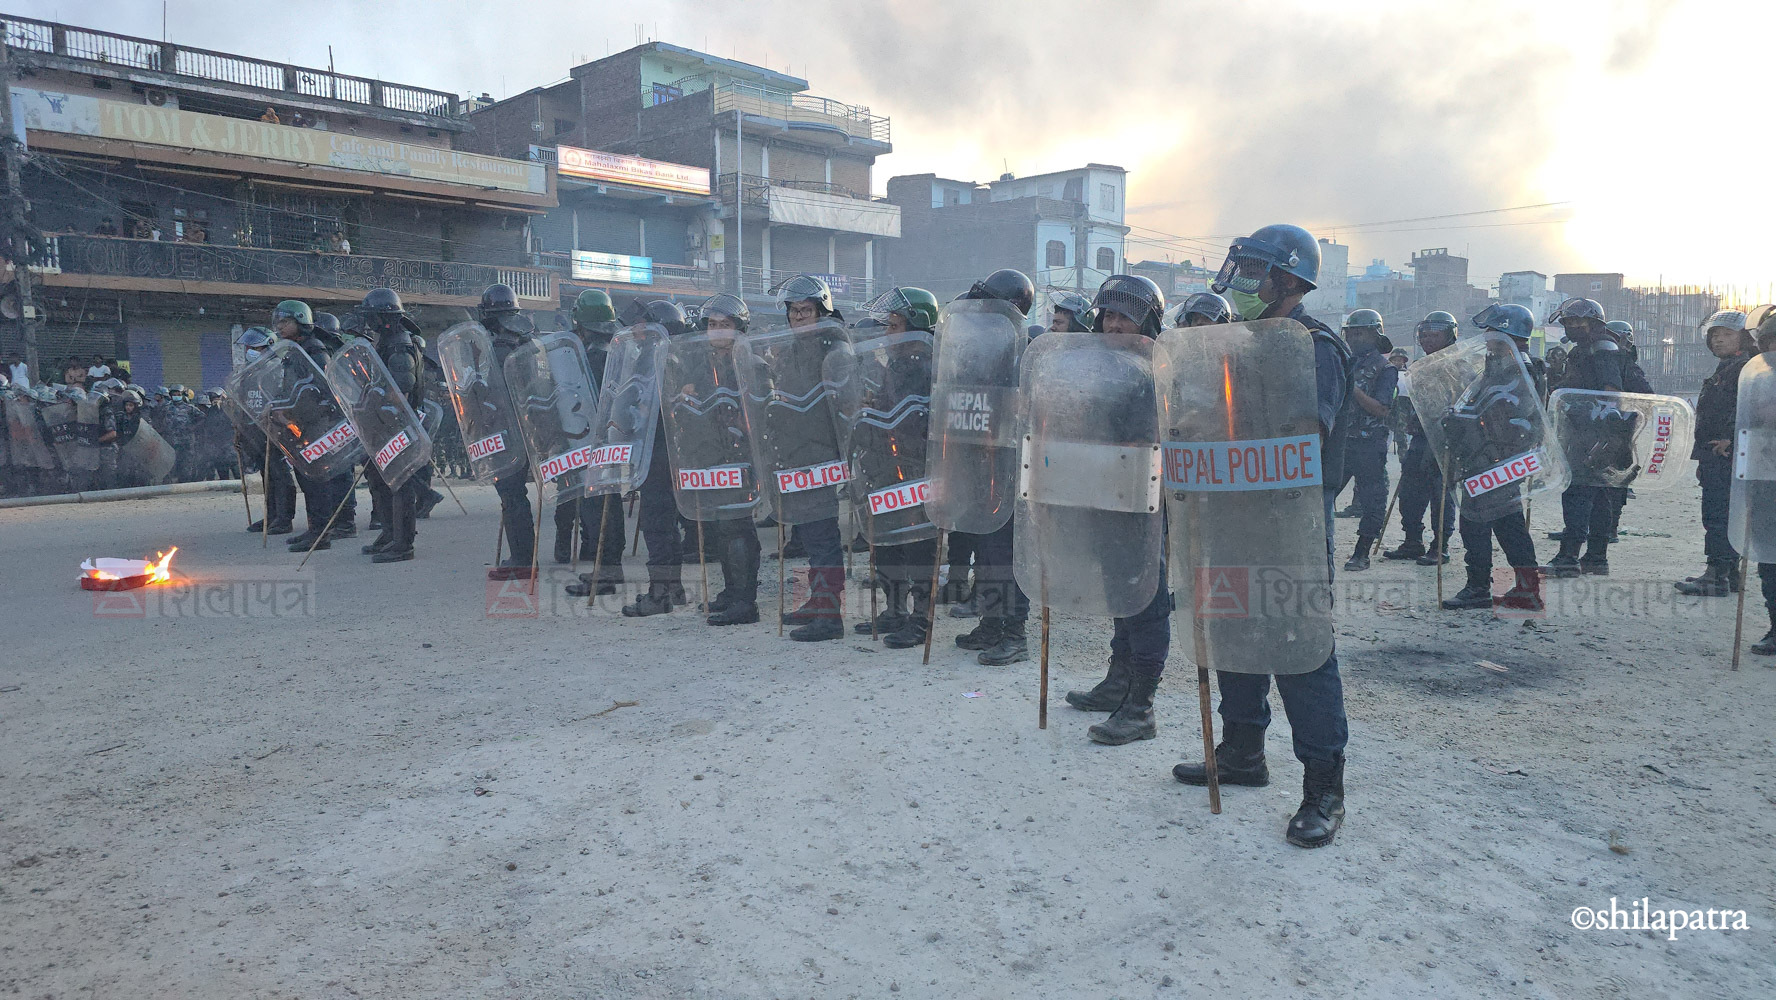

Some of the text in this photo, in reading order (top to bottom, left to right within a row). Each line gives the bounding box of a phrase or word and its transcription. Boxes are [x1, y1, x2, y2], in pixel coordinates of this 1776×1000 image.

[106, 104, 524, 176] TOM & JERRY Cafe and Family Restaurant
[584, 159, 629, 172] Mahalaxmi
[631, 167, 653, 176] Bikas
[655, 170, 674, 179] Bank
[73, 240, 256, 281] TOM & JERRY
[318, 254, 374, 274] Cafe
[384, 259, 423, 278] and
[948, 393, 991, 411] NEPAL
[947, 412, 990, 431] POLICE
[302, 424, 353, 462] POLICE
[376, 434, 406, 468] POLICE
[468, 436, 504, 459] POLICE
[591, 446, 630, 464] POLICE
[1648, 415, 1672, 474] POLICE
[541, 447, 591, 480] POLICE
[780, 463, 850, 491] POLICE
[1165, 442, 1314, 484] NEPAL POLICE
[1466, 455, 1540, 495] POLICE
[680, 470, 740, 488] POLICE
